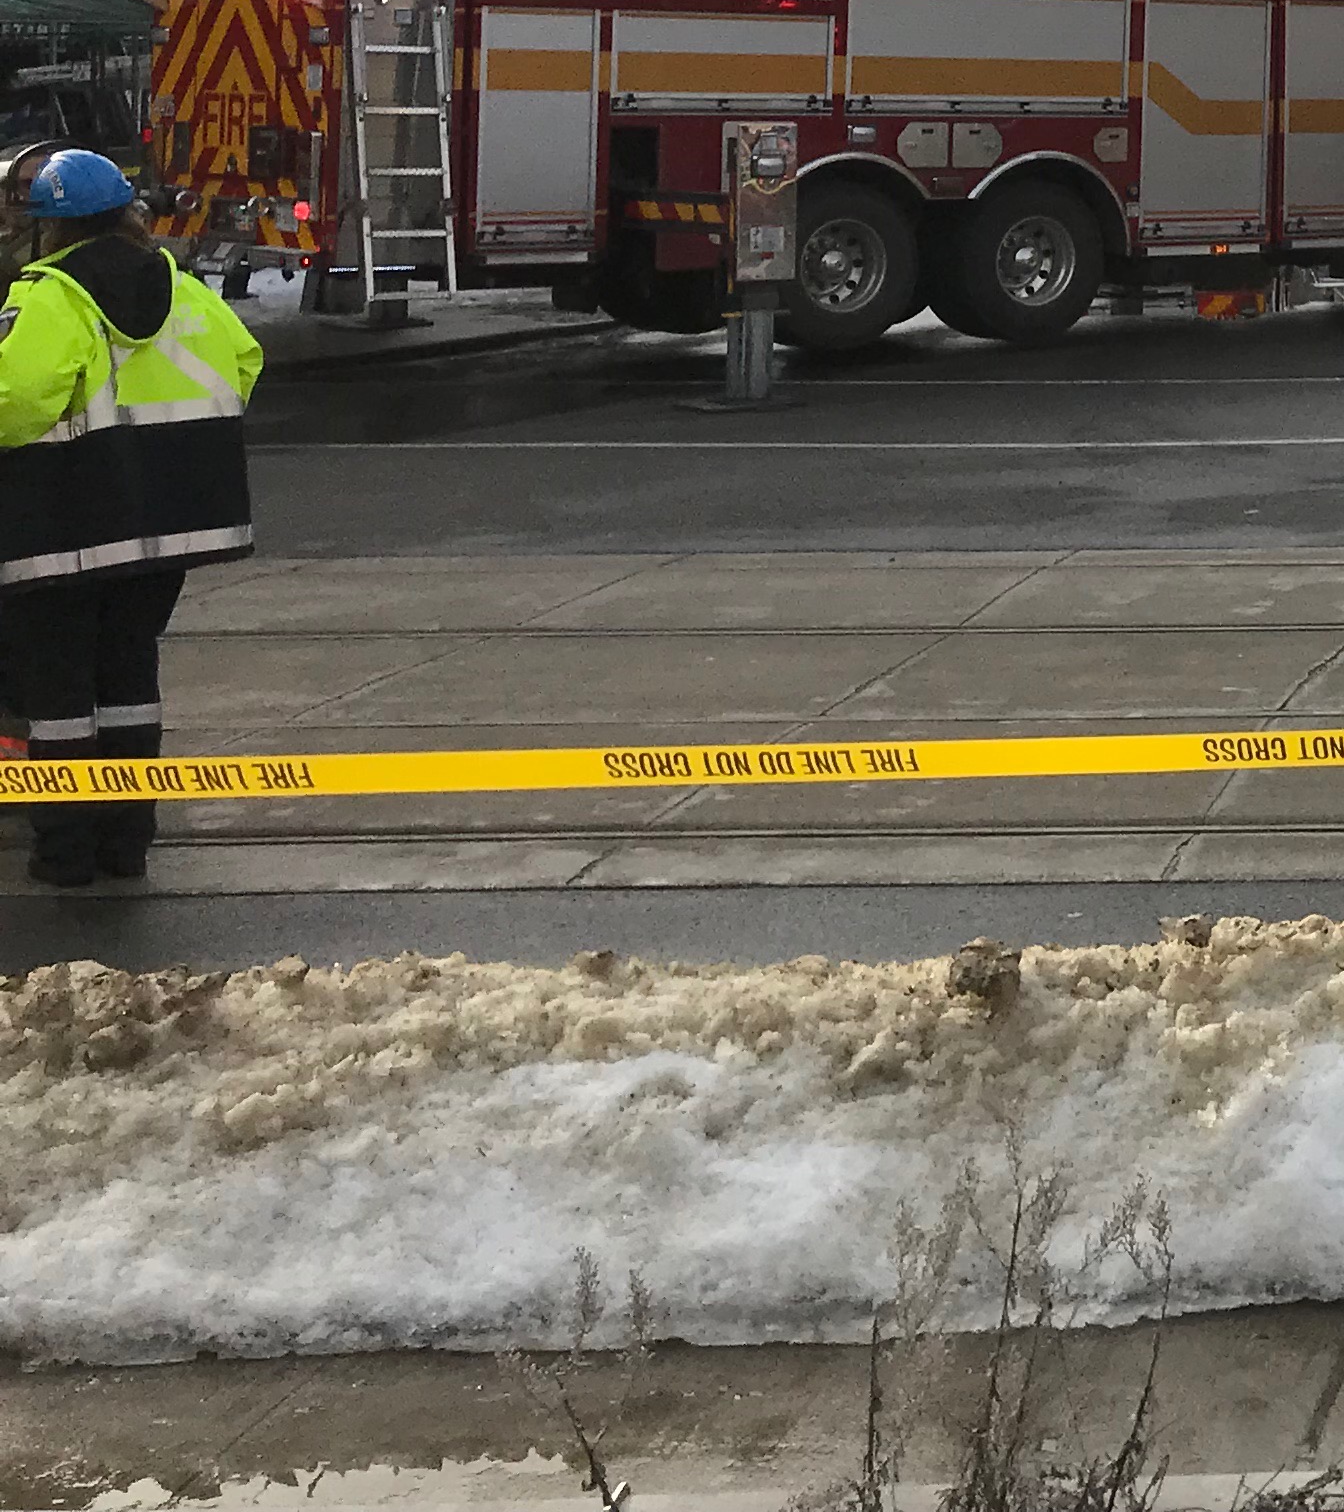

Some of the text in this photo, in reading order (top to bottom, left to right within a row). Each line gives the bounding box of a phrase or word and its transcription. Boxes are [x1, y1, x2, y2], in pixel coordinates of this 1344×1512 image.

[203, 90, 267, 146] FIRE
[1202, 736, 1286, 763] CROSS
[251, 762, 315, 789] FIRE
[603, 748, 920, 779] FIRE LINE DO NOT CROSS
[89, 765, 142, 794] NOT
[146, 765, 185, 792] DO
[185, 764, 250, 791] LINE
